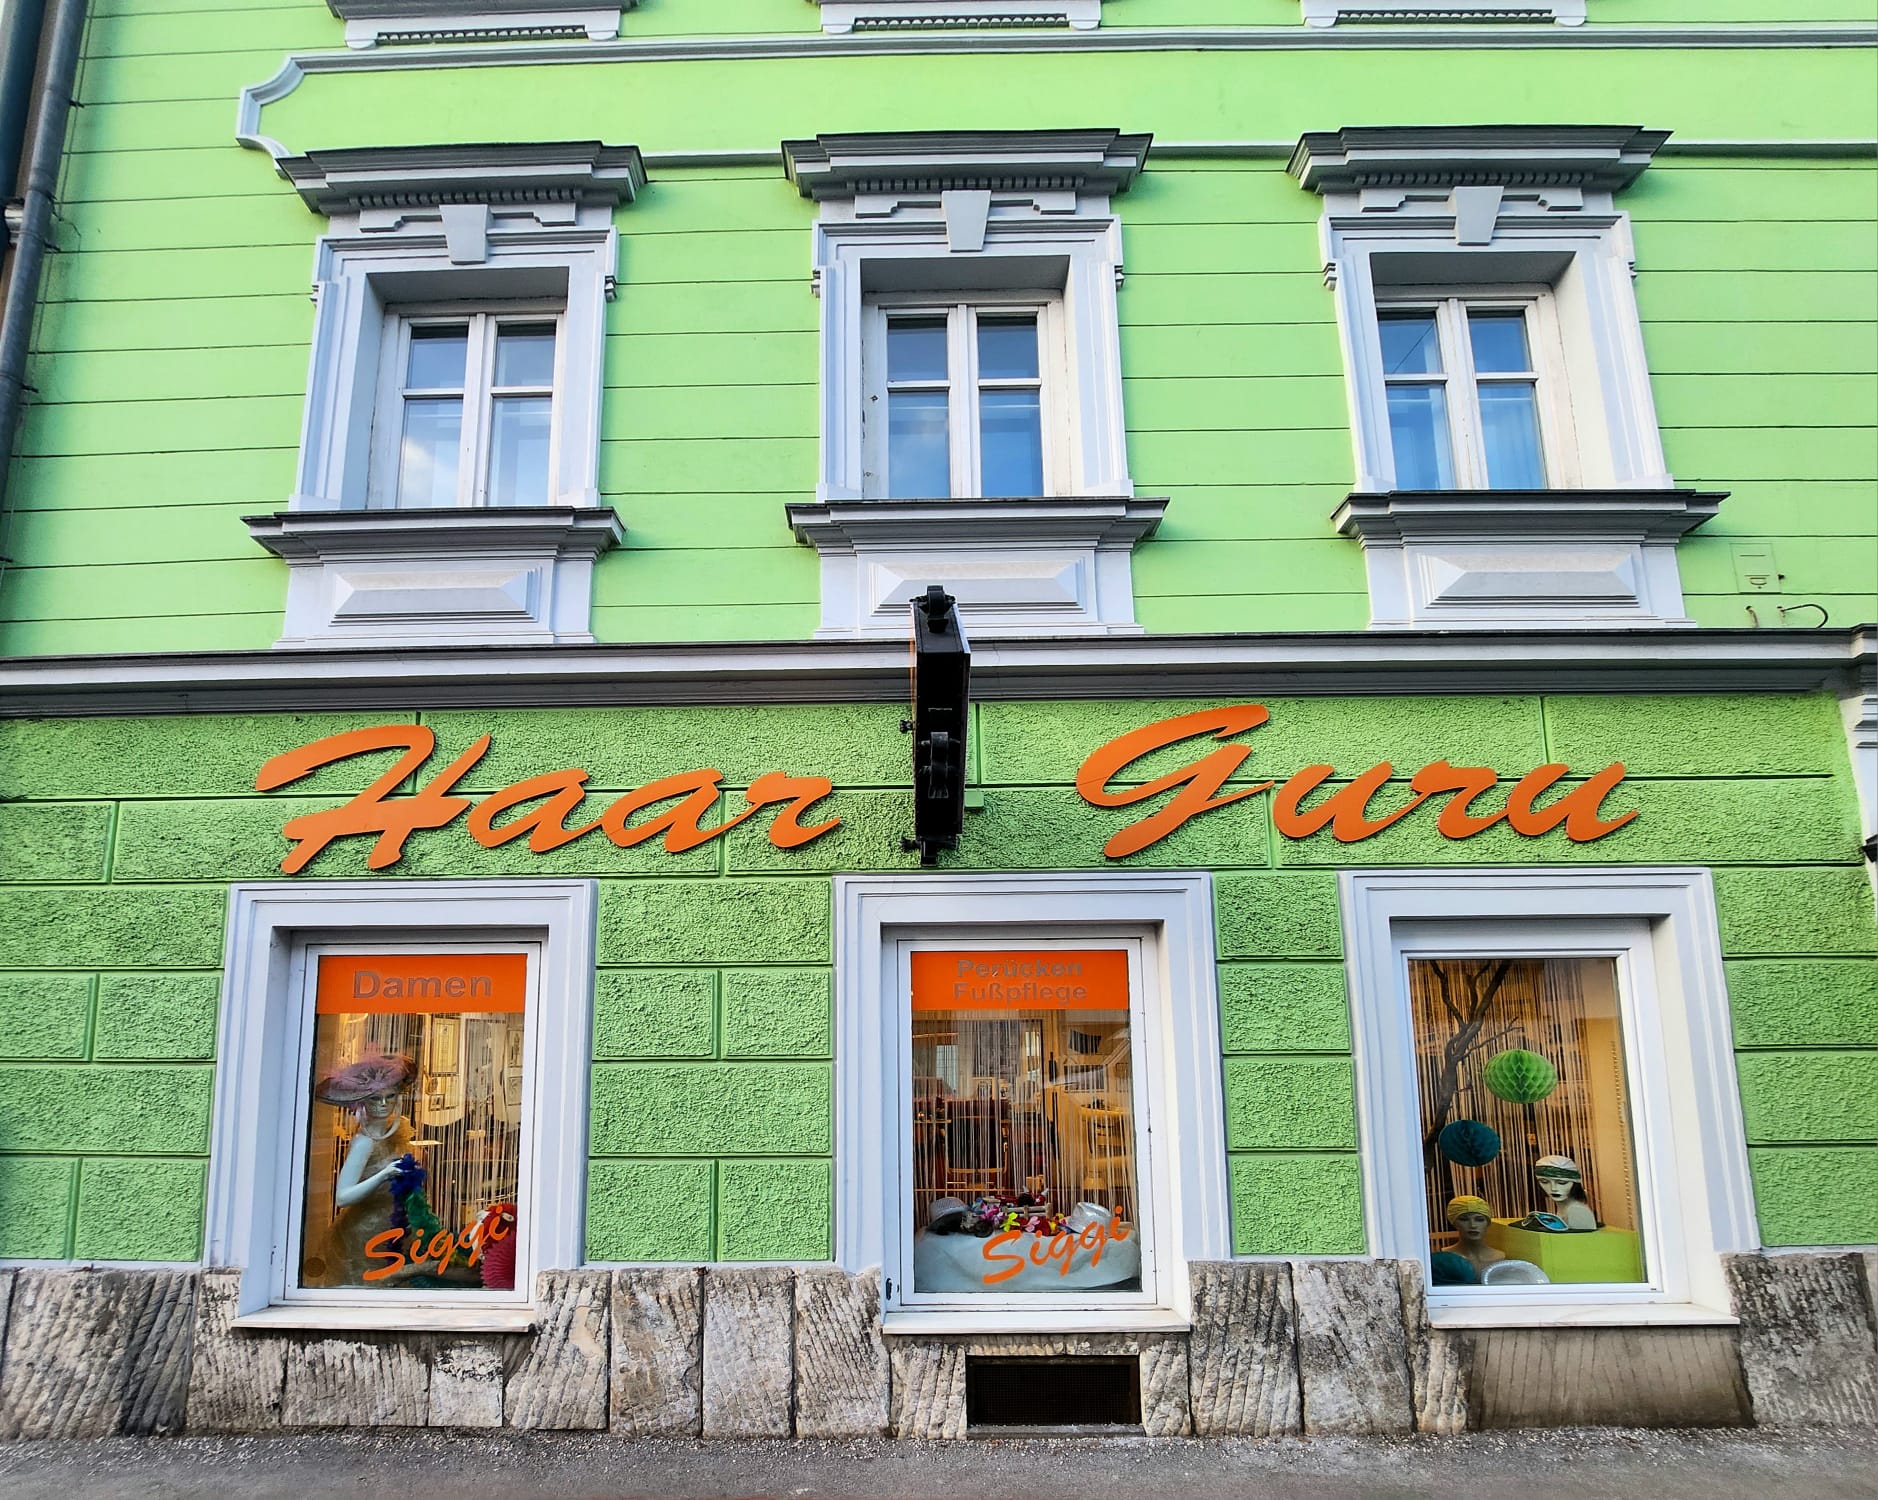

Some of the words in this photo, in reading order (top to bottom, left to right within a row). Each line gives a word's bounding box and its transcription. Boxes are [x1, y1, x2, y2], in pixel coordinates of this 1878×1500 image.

[255, 724, 842, 875] Haar
[1075, 703, 1639, 858] Guru
[354, 971, 492, 999] Damen
[953, 982, 1087, 1005] Fußpflege
[957, 959, 1082, 977] Perücken
[363, 1205, 509, 1281] Siggi
[983, 1205, 1130, 1284] Siggi
